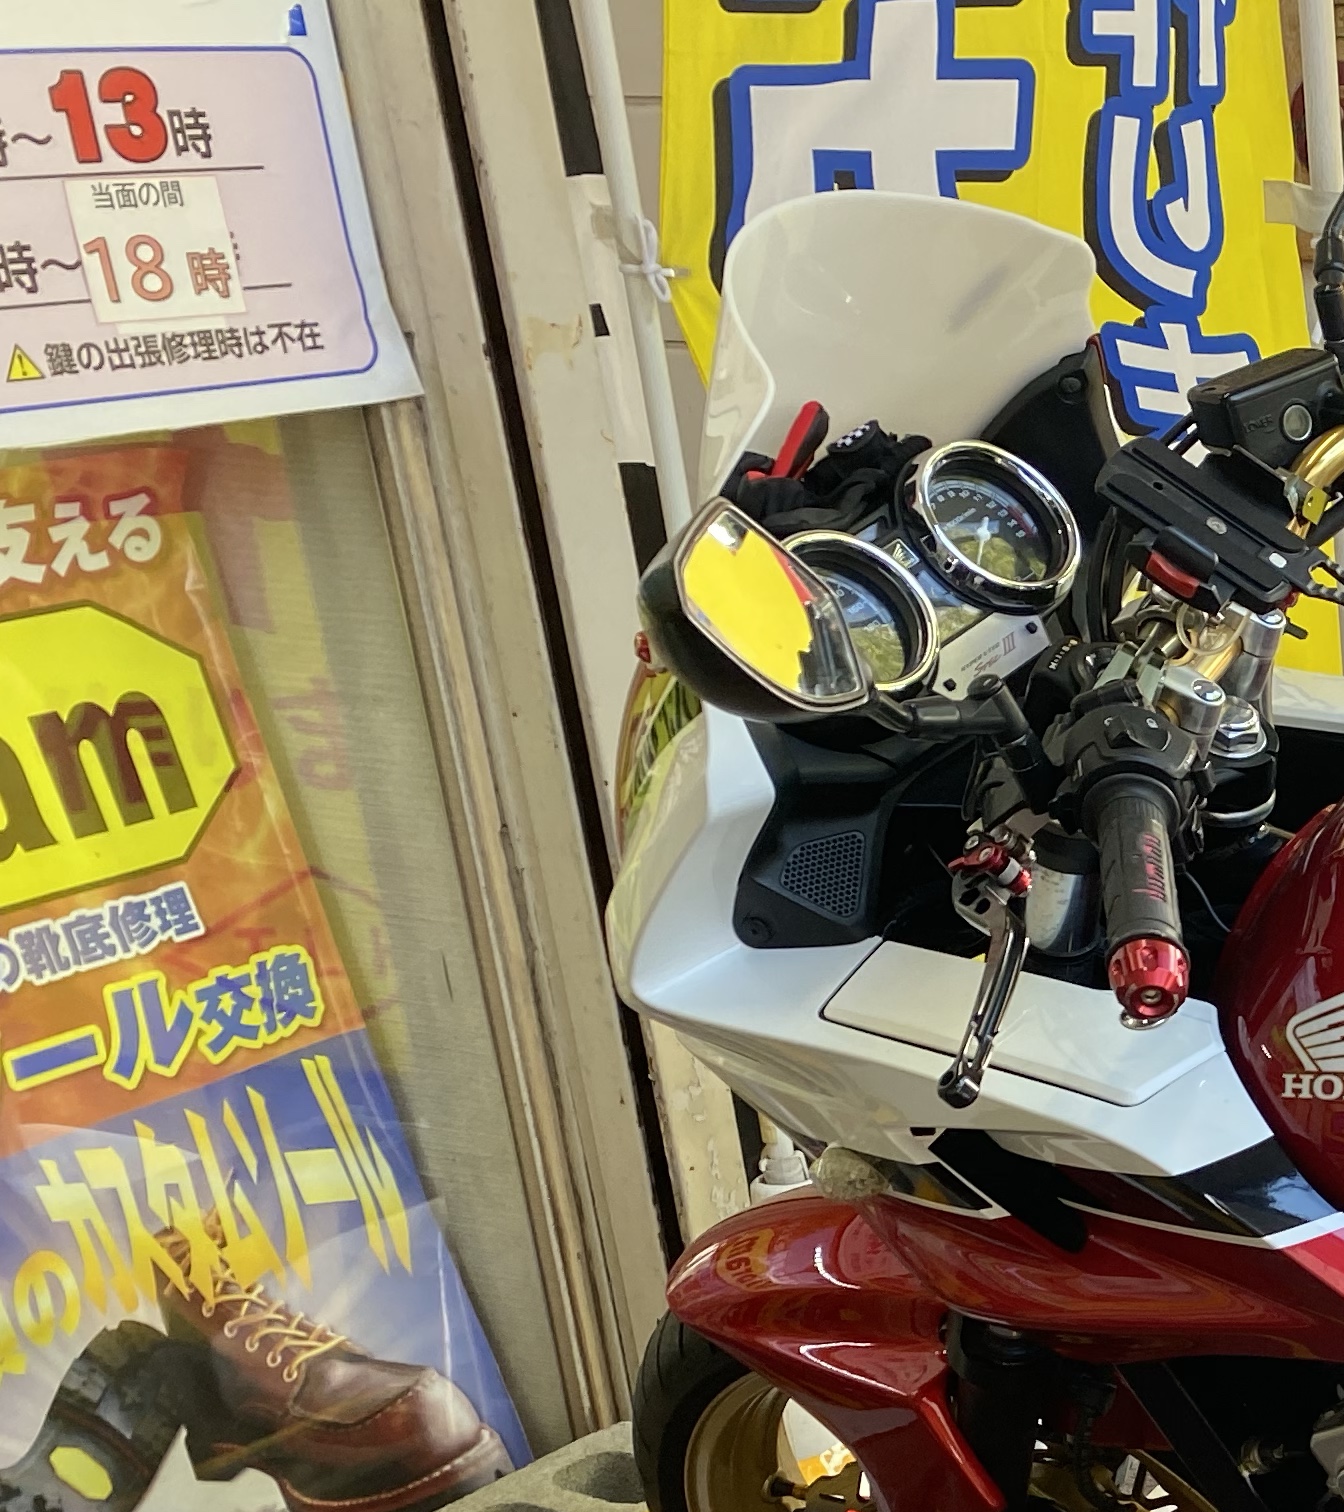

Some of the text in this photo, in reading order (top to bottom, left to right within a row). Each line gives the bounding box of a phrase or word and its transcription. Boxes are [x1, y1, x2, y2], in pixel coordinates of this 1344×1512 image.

[0, 66, 212, 168] ～13時
[91, 180, 184, 209] 当面の間
[43, 319, 324, 376] 鍵の出張修理時は不在
